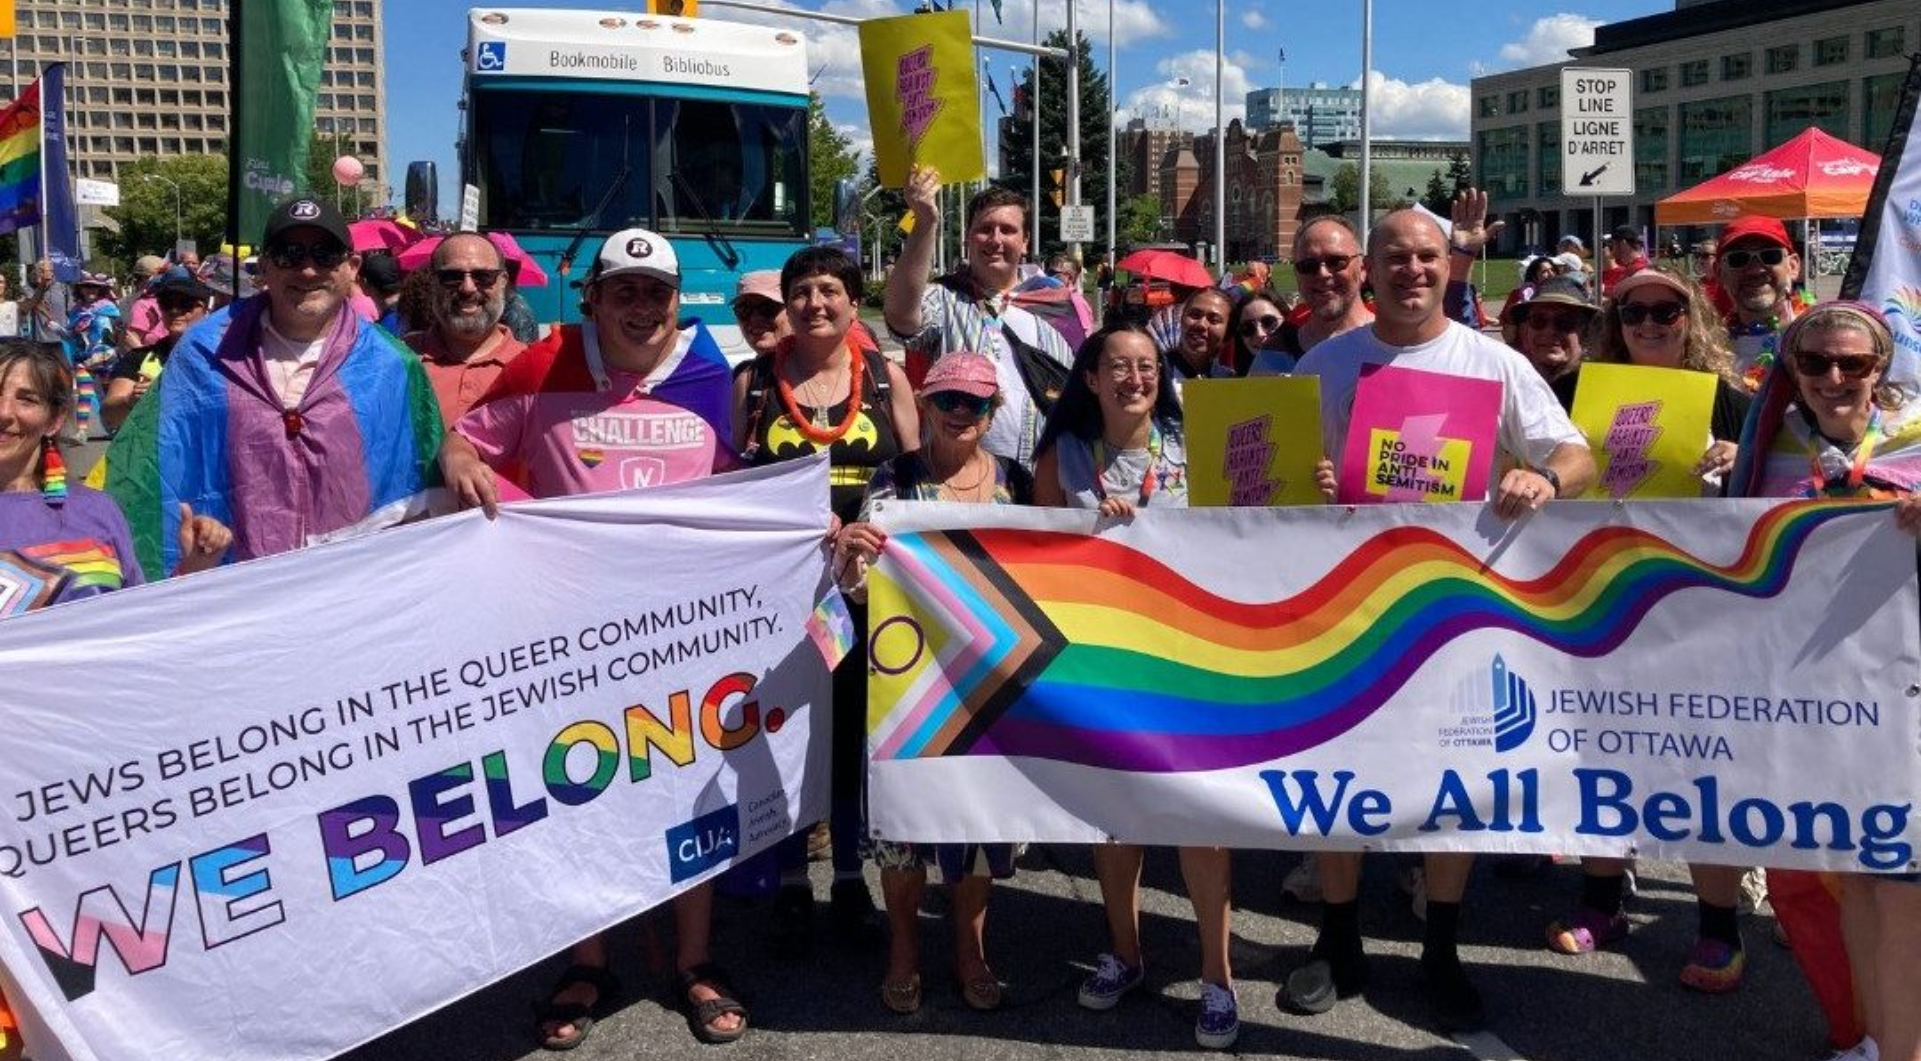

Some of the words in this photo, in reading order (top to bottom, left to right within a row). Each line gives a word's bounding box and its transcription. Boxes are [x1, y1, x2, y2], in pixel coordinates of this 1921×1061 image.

[550, 51, 638, 71] Bookmobile
[664, 56, 730, 76] Bibliobus
[1576, 79, 1617, 94] STOP
[1579, 98, 1614, 112] LINE
[1574, 121, 1619, 136] LIGNE
[631, 240, 648, 254] R
[572, 416, 705, 445] CHALLENGE
[1381, 438, 1406, 452] NO
[1377, 462, 1417, 477] ANTI
[1379, 451, 1428, 468] PRIDE
[1431, 456, 1450, 471] IN
[1375, 474, 1455, 496] SEMITISM
[15, 761, 145, 822] JEWS
[157, 707, 326, 780] BELONG
[337, 692, 374, 726] IN
[381, 668, 452, 710] THE
[459, 635, 570, 689] QUEER
[578, 584, 763, 651] COMMUNITY,
[1545, 689, 1658, 718] JEWISH
[1669, 693, 1880, 727] FEDERATION
[0, 799, 178, 878] QUEERS
[189, 742, 354, 818] BELONG
[364, 726, 400, 760] IN
[407, 702, 476, 744] THE
[482, 664, 599, 722] JEWISH
[607, 613, 784, 682] COMMUNITY.
[1547, 729, 1588, 753] OF
[1598, 730, 1734, 762] OTTAWA
[1259, 769, 1392, 837] We
[1417, 767, 1546, 833] All
[1572, 767, 1913, 871] Belong
[18, 832, 286, 1002] WE
[317, 671, 785, 902] BELONG.
[678, 827, 733, 863] CIJA
